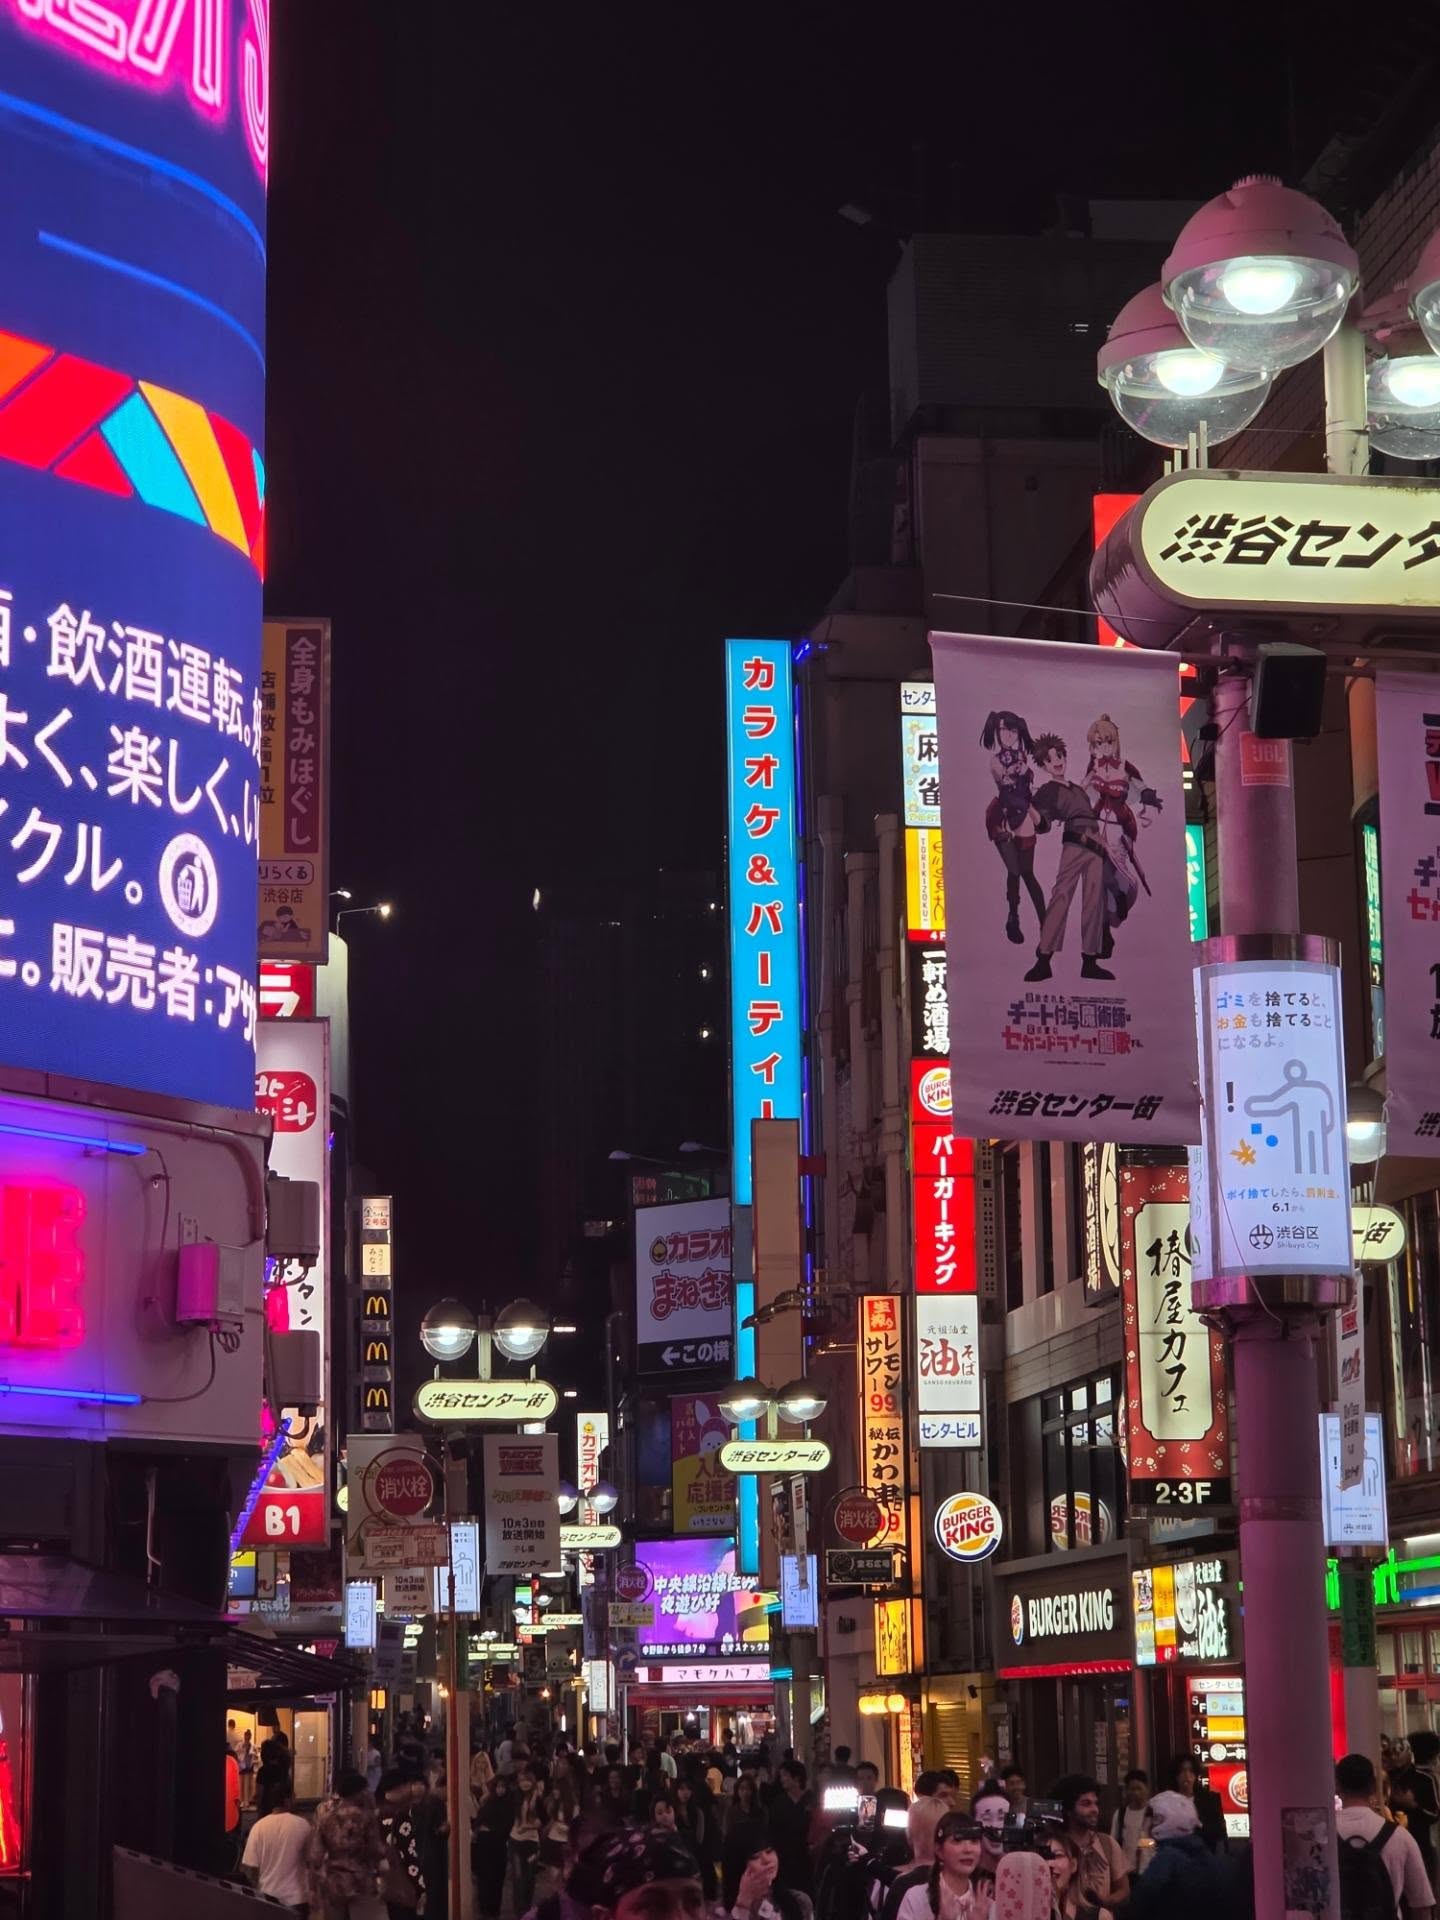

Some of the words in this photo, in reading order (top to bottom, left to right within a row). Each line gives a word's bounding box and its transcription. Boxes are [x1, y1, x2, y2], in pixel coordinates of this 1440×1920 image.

[289, 635, 317, 846] 全身もみほぐし
[0, 797, 144, 906] クル。
[263, 887, 304, 905] 渋谷店
[921, 949, 951, 1055] 一軒め酒場
[1216, 991, 1327, 1010] ゴミを捨てると、
[1216, 1012, 1333, 1030] お金も捨てること
[1217, 1033, 1285, 1051] になるよ。
[988, 1089, 1164, 1121] 渋谷センター街
[931, 1132, 957, 1286] バーガーキング
[1276, 1225, 1319, 1240] 渋谷区
[927, 1324, 969, 1335] 元祖油堂
[1145, 1229, 1193, 1413] 椿屋カフェ
[865, 1336, 883, 1392] サワー
[883, 1332, 900, 1391] レモン
[919, 1337, 961, 1379] 油
[961, 1343, 976, 1377] そば
[424, 1393, 550, 1410] 渋谷センター街
[870, 1394, 898, 1413] 99
[868, 1427, 900, 1441] 秘伝
[921, 1421, 979, 1441] センタービル
[581, 1434, 599, 1493] カラオケ
[727, 1450, 826, 1463] 渋谷センター街
[379, 1476, 428, 1500] 消火栓
[264, 1505, 301, 1537] B1
[839, 1511, 879, 1529] 消火栓
[943, 1504, 993, 1532] BURGER
[501, 1529, 545, 1542] 放送開始
[945, 1517, 995, 1547] KING
[1029, 1595, 1077, 1638] BURGER
[1079, 1588, 1114, 1632] KING
[1192, 1696, 1207, 1713] 5F
[1193, 1719, 1208, 1738] 4F
[1194, 1744, 1210, 1762] 3F
